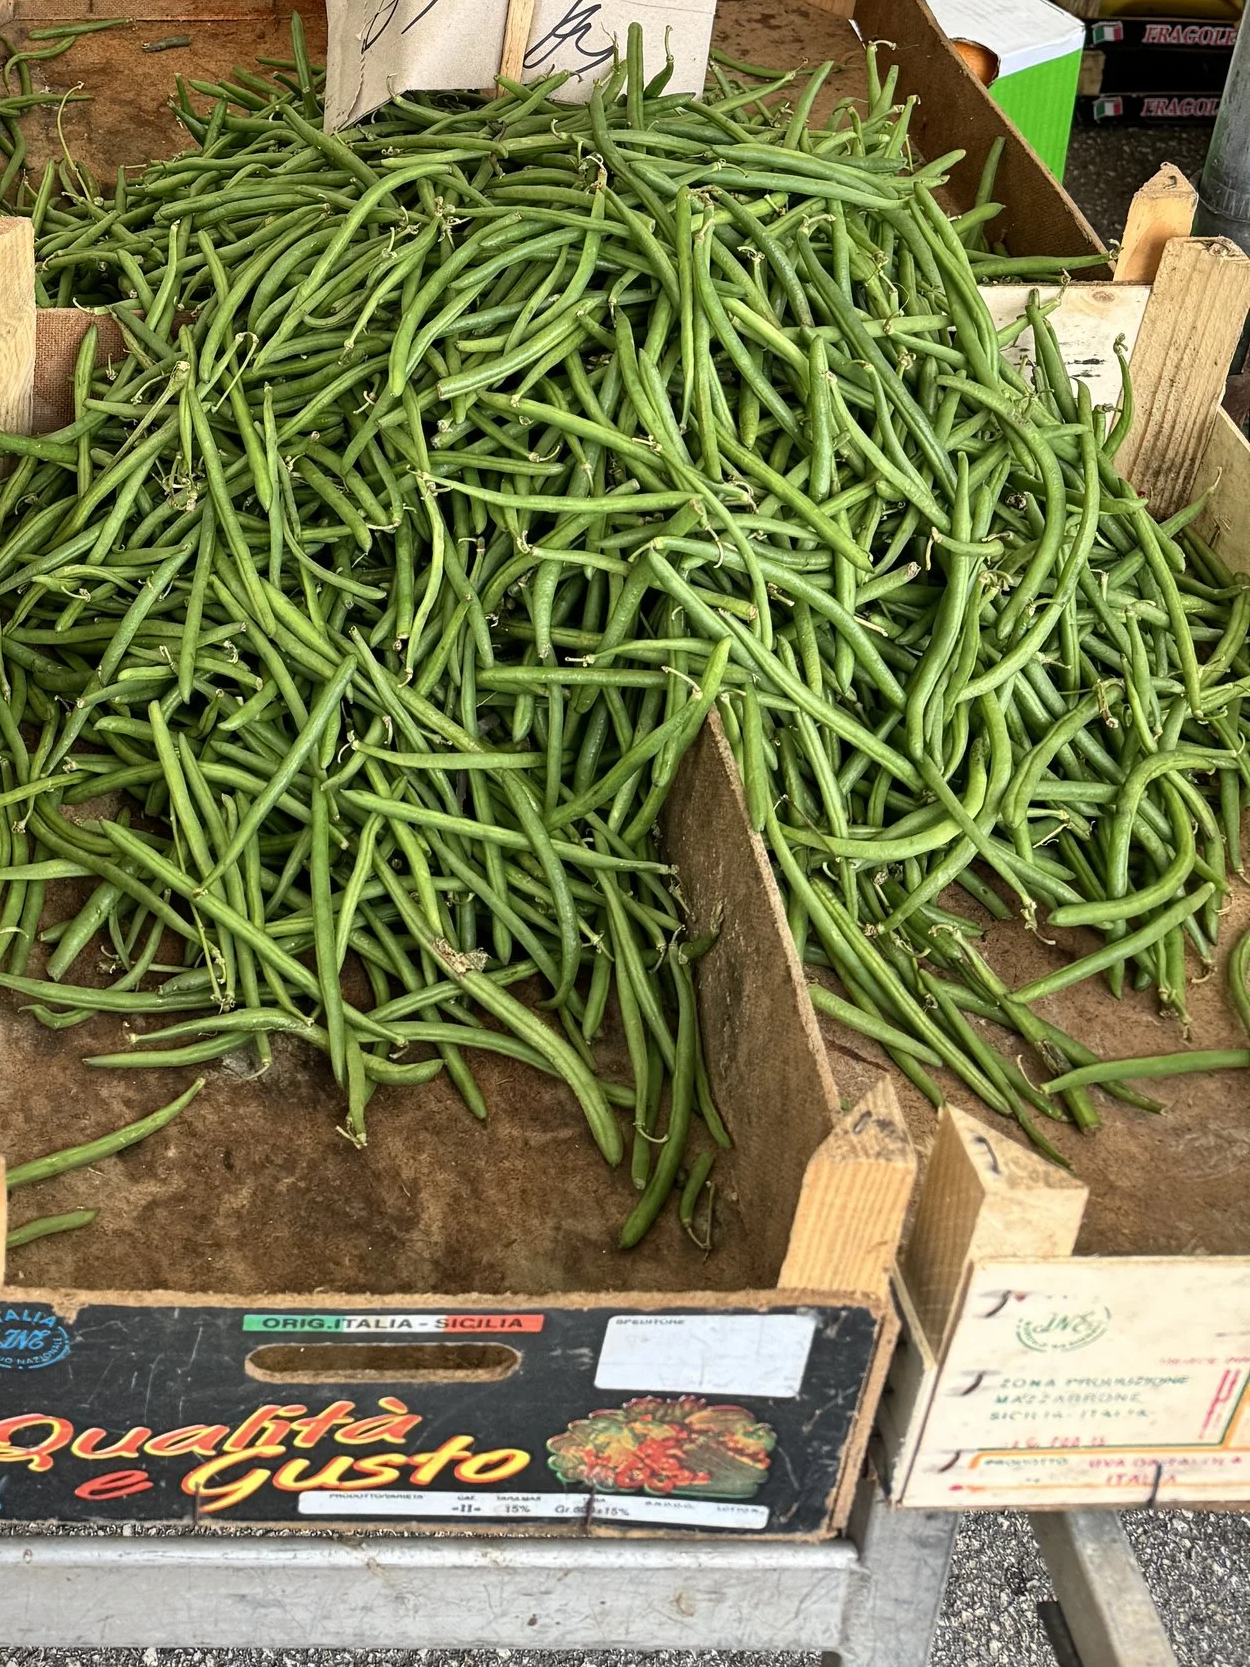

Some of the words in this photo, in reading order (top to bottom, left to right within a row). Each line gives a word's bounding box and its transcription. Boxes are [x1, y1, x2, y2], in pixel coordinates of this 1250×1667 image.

[1141, 24, 1237, 46] FRAGOLE
[1140, 97, 1219, 117] FRAGOL
[434, 1317, 523, 1329] SICILIA
[74, 1470, 153, 1501] e
[182, 1436, 531, 1513] Gusto
